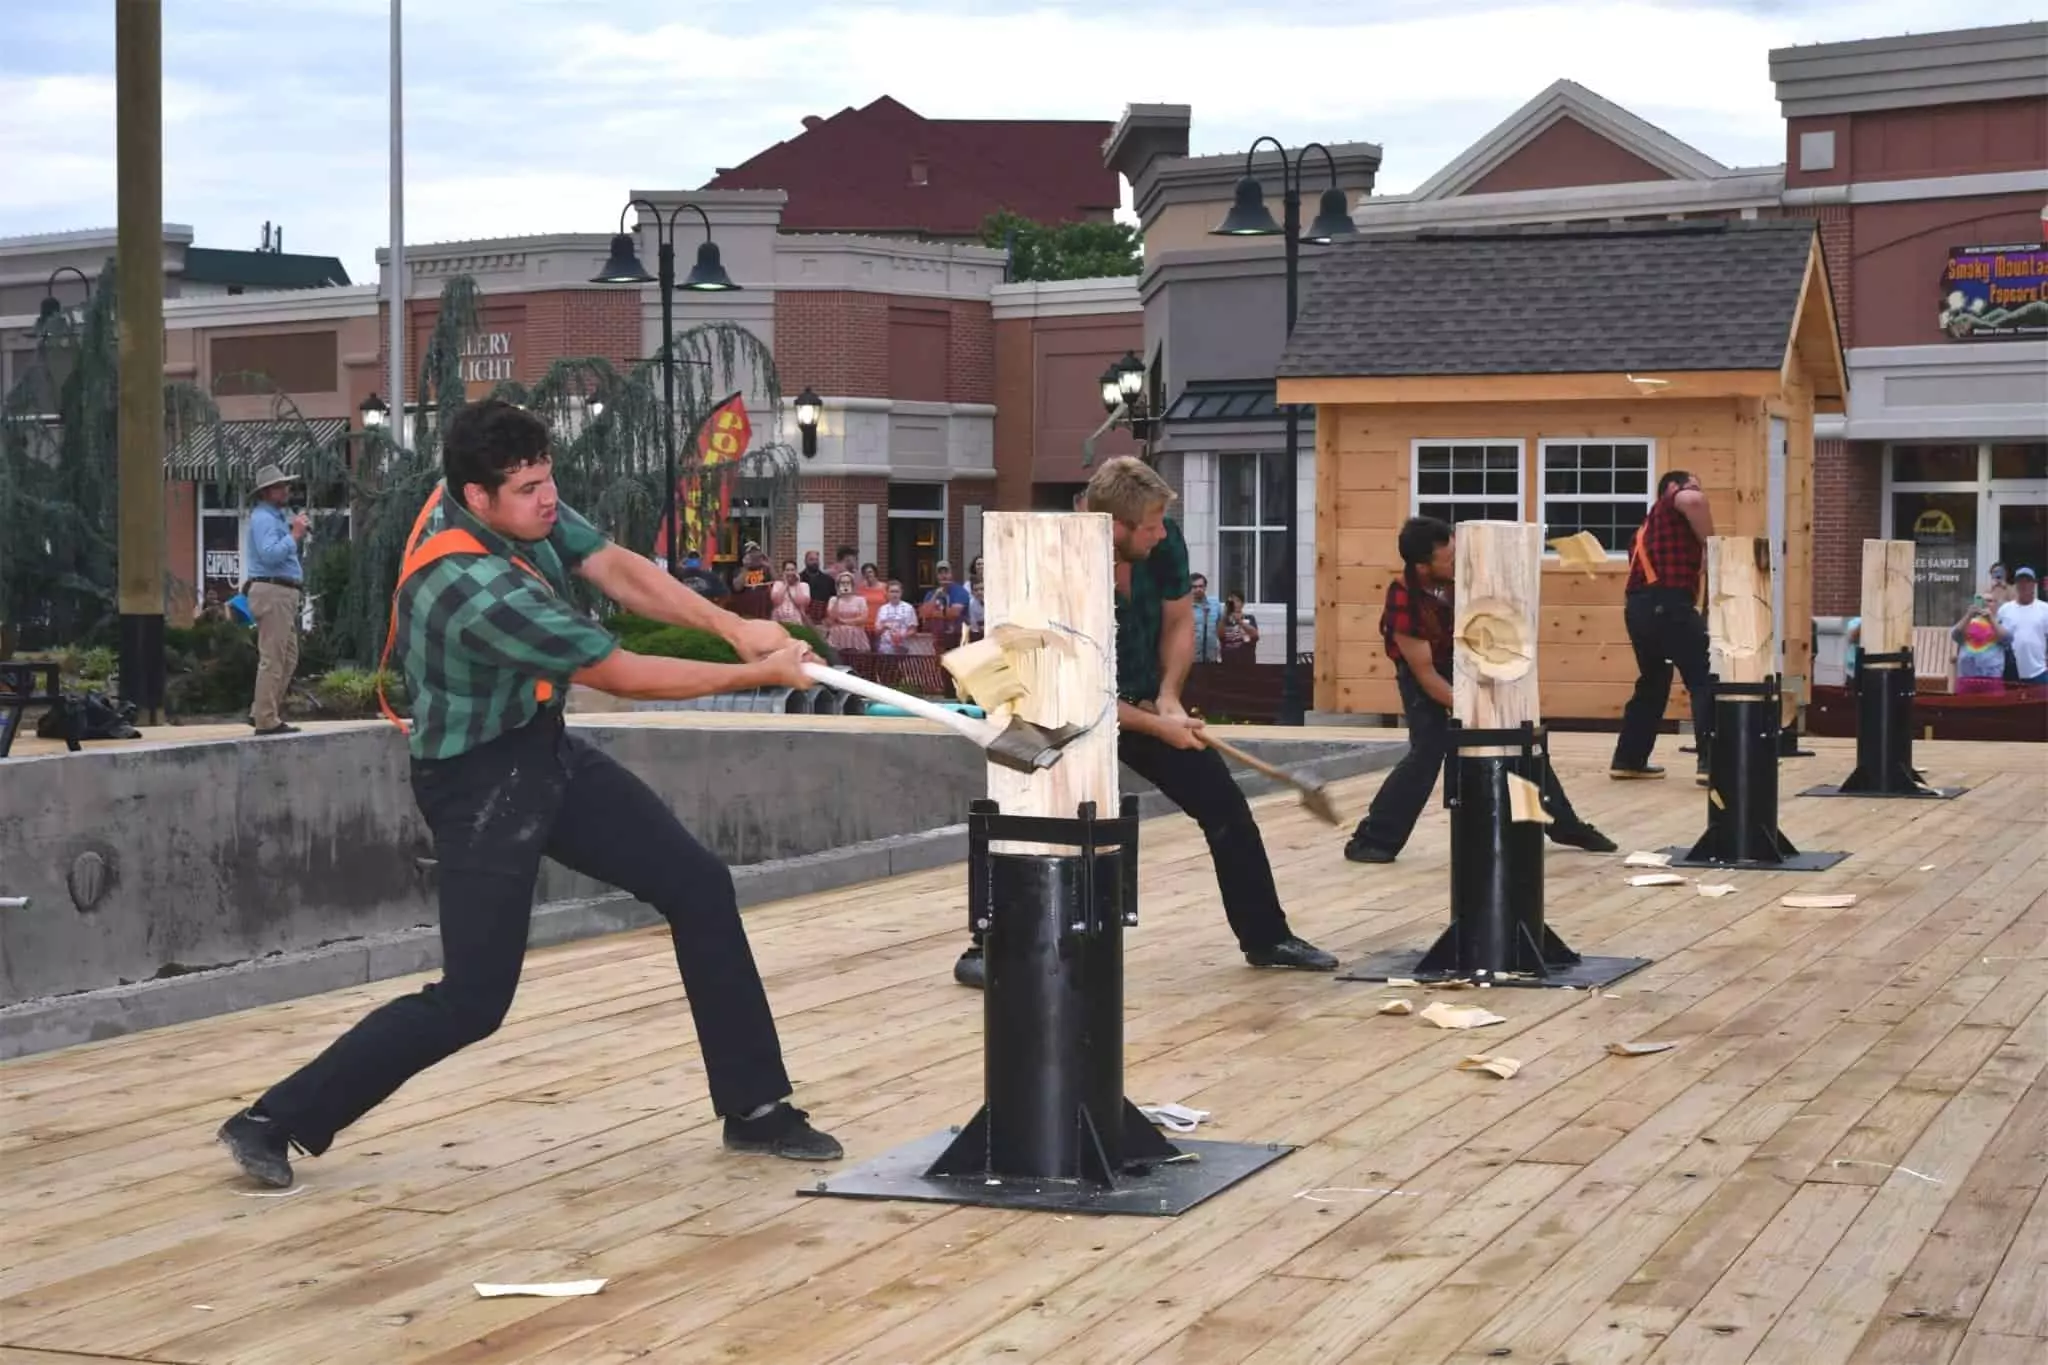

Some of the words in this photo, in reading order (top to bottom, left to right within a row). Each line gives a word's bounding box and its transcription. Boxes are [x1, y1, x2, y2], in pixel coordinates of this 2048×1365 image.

[1948, 258, 1990, 284] Smoky
[1990, 284, 2038, 306] Popcorn
[458, 358, 514, 381] LIGHT
[1928, 558, 1969, 568] SAMPLES
